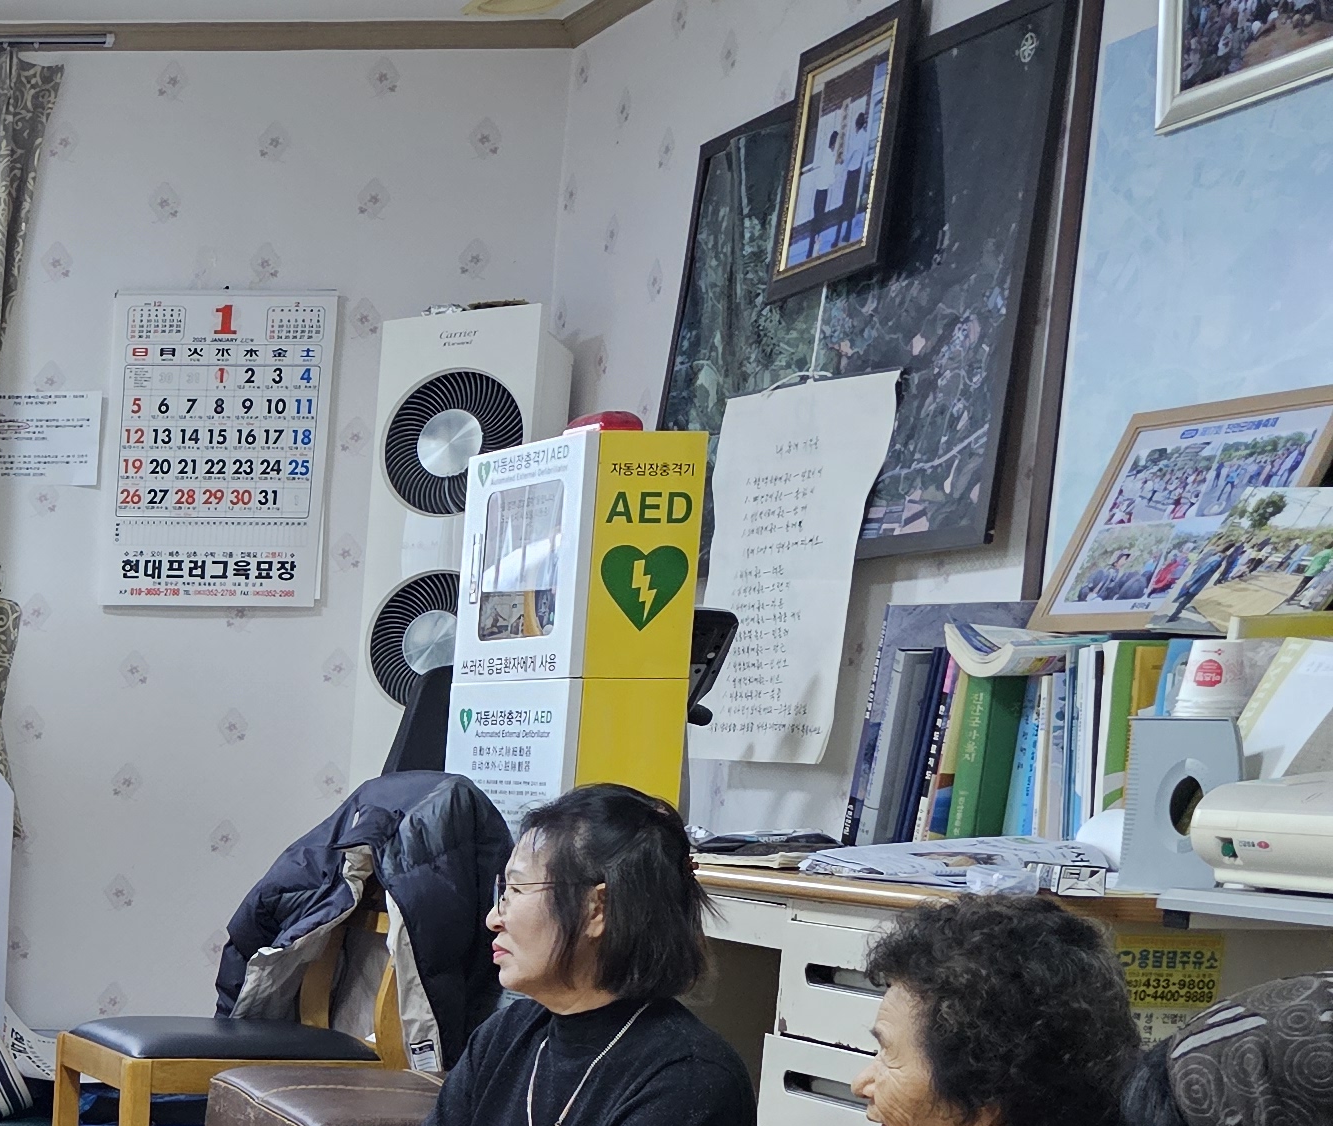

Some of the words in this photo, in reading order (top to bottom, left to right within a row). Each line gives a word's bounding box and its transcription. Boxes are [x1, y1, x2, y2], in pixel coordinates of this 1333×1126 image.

[214, 305, 237, 334] 1
[440, 330, 478, 339] Carrier
[133, 348, 148, 357] 日
[160, 348, 176, 357] 月
[188, 348, 203, 357] 火
[215, 348, 231, 357] 水
[244, 348, 259, 357] 木
[272, 348, 287, 357] 金
[300, 348, 315, 357] 土
[218, 368, 225, 383] 1
[244, 368, 255, 383] 2
[272, 368, 283, 384] 3
[300, 368, 312, 383] 4
[131, 398, 141, 414] 5
[158, 398, 169, 414] 6
[186, 399, 198, 414] 7
[214, 398, 224, 414] 8
[242, 398, 253, 414] 9
[266, 398, 286, 414] 10
[295, 399, 312, 414] 11
[125, 428, 144, 443] 12
[153, 428, 171, 444] 13
[180, 429, 199, 444] 14
[208, 429, 227, 445] 15
[237, 429, 256, 445] 16
[264, 429, 284, 445] 17
[292, 429, 311, 445] 18
[123, 459, 143, 474] 19
[149, 459, 171, 474] 20
[178, 459, 196, 474] 21
[205, 459, 226, 475] 22
[233, 459, 253, 475] 23
[260, 459, 281, 475] 24
[288, 460, 309, 476] 25
[492, 448, 549, 475] 자동심장충격기
[550, 445, 569, 460] AED
[611, 461, 696, 478] 자동심장충격기
[120, 489, 141, 504] 26
[147, 489, 169, 504] 27
[174, 489, 195, 505] 28
[202, 489, 224, 505] 29
[230, 489, 252, 505] 30
[258, 490, 277, 505] 31
[605, 492, 693, 523] AED
[122, 559, 296, 581] 현대프러그육묘장
[461, 659, 484, 675] 쓰러진
[487, 655, 537, 675] 응급환자에게
[475, 710, 530, 726] 자동심장충격기
[533, 711, 552, 723] AED
[475, 730, 501, 738] Automated
[502, 730, 520, 738] External
[522, 730, 550, 738] Defibrillator
[1138, 949, 1218, 970] 용담댐주유소
